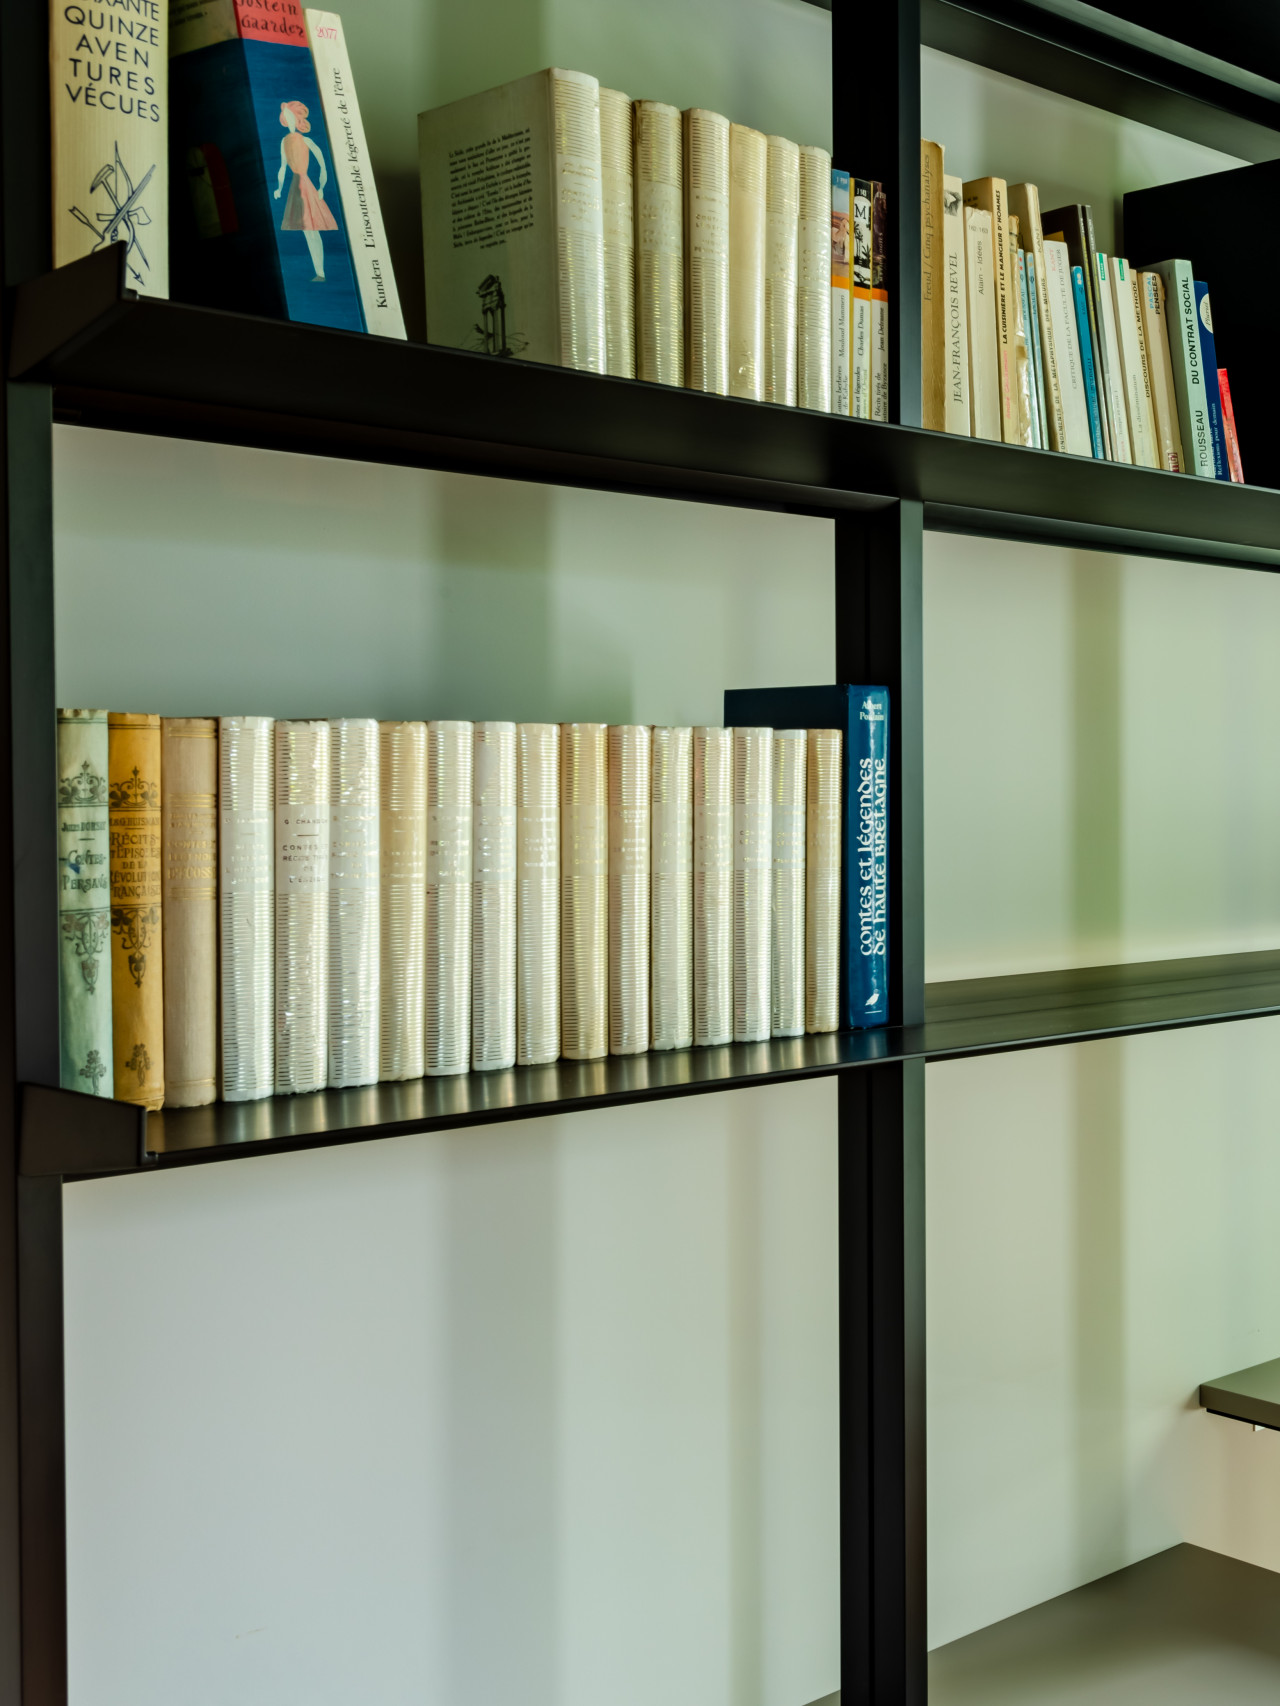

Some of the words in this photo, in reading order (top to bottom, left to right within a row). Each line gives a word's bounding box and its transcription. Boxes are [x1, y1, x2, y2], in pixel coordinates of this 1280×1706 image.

[64, 5, 159, 47] QUINZE
[241, 14, 304, 37] Gaarder
[316, 26, 338, 41] 2077
[75, 33, 149, 69] AVEN
[68, 58, 155, 95] TURES
[333, 67, 345, 97] l'être
[65, 82, 160, 122] VÉCUES
[337, 99, 349, 115] de
[340, 117, 359, 162] légèreté
[921, 154, 934, 229] psychanalyses
[350, 165, 376, 249] L'insoutenable
[995, 190, 1003, 231] D'HOMMES
[922, 232, 934, 259] Cinq
[949, 252, 960, 294] REVEL
[1056, 248, 1065, 274] JUGER
[371, 259, 388, 308] Kundera
[922, 271, 932, 301] Freud
[977, 273, 985, 295] Alain
[999, 272, 1005, 281] LE
[1000, 283, 1006, 291] ET
[1146, 276, 1155, 309] PASCAL
[1181, 276, 1192, 315] SOCIAL
[857, 305, 865, 330] Dumas
[1064, 325, 1071, 337] LA
[857, 330, 865, 357] Charles
[878, 335, 886, 352] Jean
[1001, 334, 1008, 344] LA
[1066, 338, 1073, 350] DE
[1137, 326, 1143, 337] LA
[1139, 339, 1145, 351] DE
[1185, 318, 1198, 368] CONTRAT
[949, 297, 964, 404] JEAN-FRANÇOIS
[880, 363, 888, 390] Byzance
[1067, 350, 1078, 390] CRITIQUE
[1140, 353, 1151, 398] DISCOURS
[1191, 370, 1200, 385] DU
[1053, 382, 1059, 391] LA
[1054, 395, 1061, 404] DE
[1056, 409, 1066, 450] ONDEMENTS
[1195, 410, 1209, 468] ROUSSEAU
[1215, 442, 1223, 476] Réflexions
[110, 832, 157, 847] RÉCITS
[122, 861, 136, 870] DE
[62, 874, 108, 894] PERSANS
